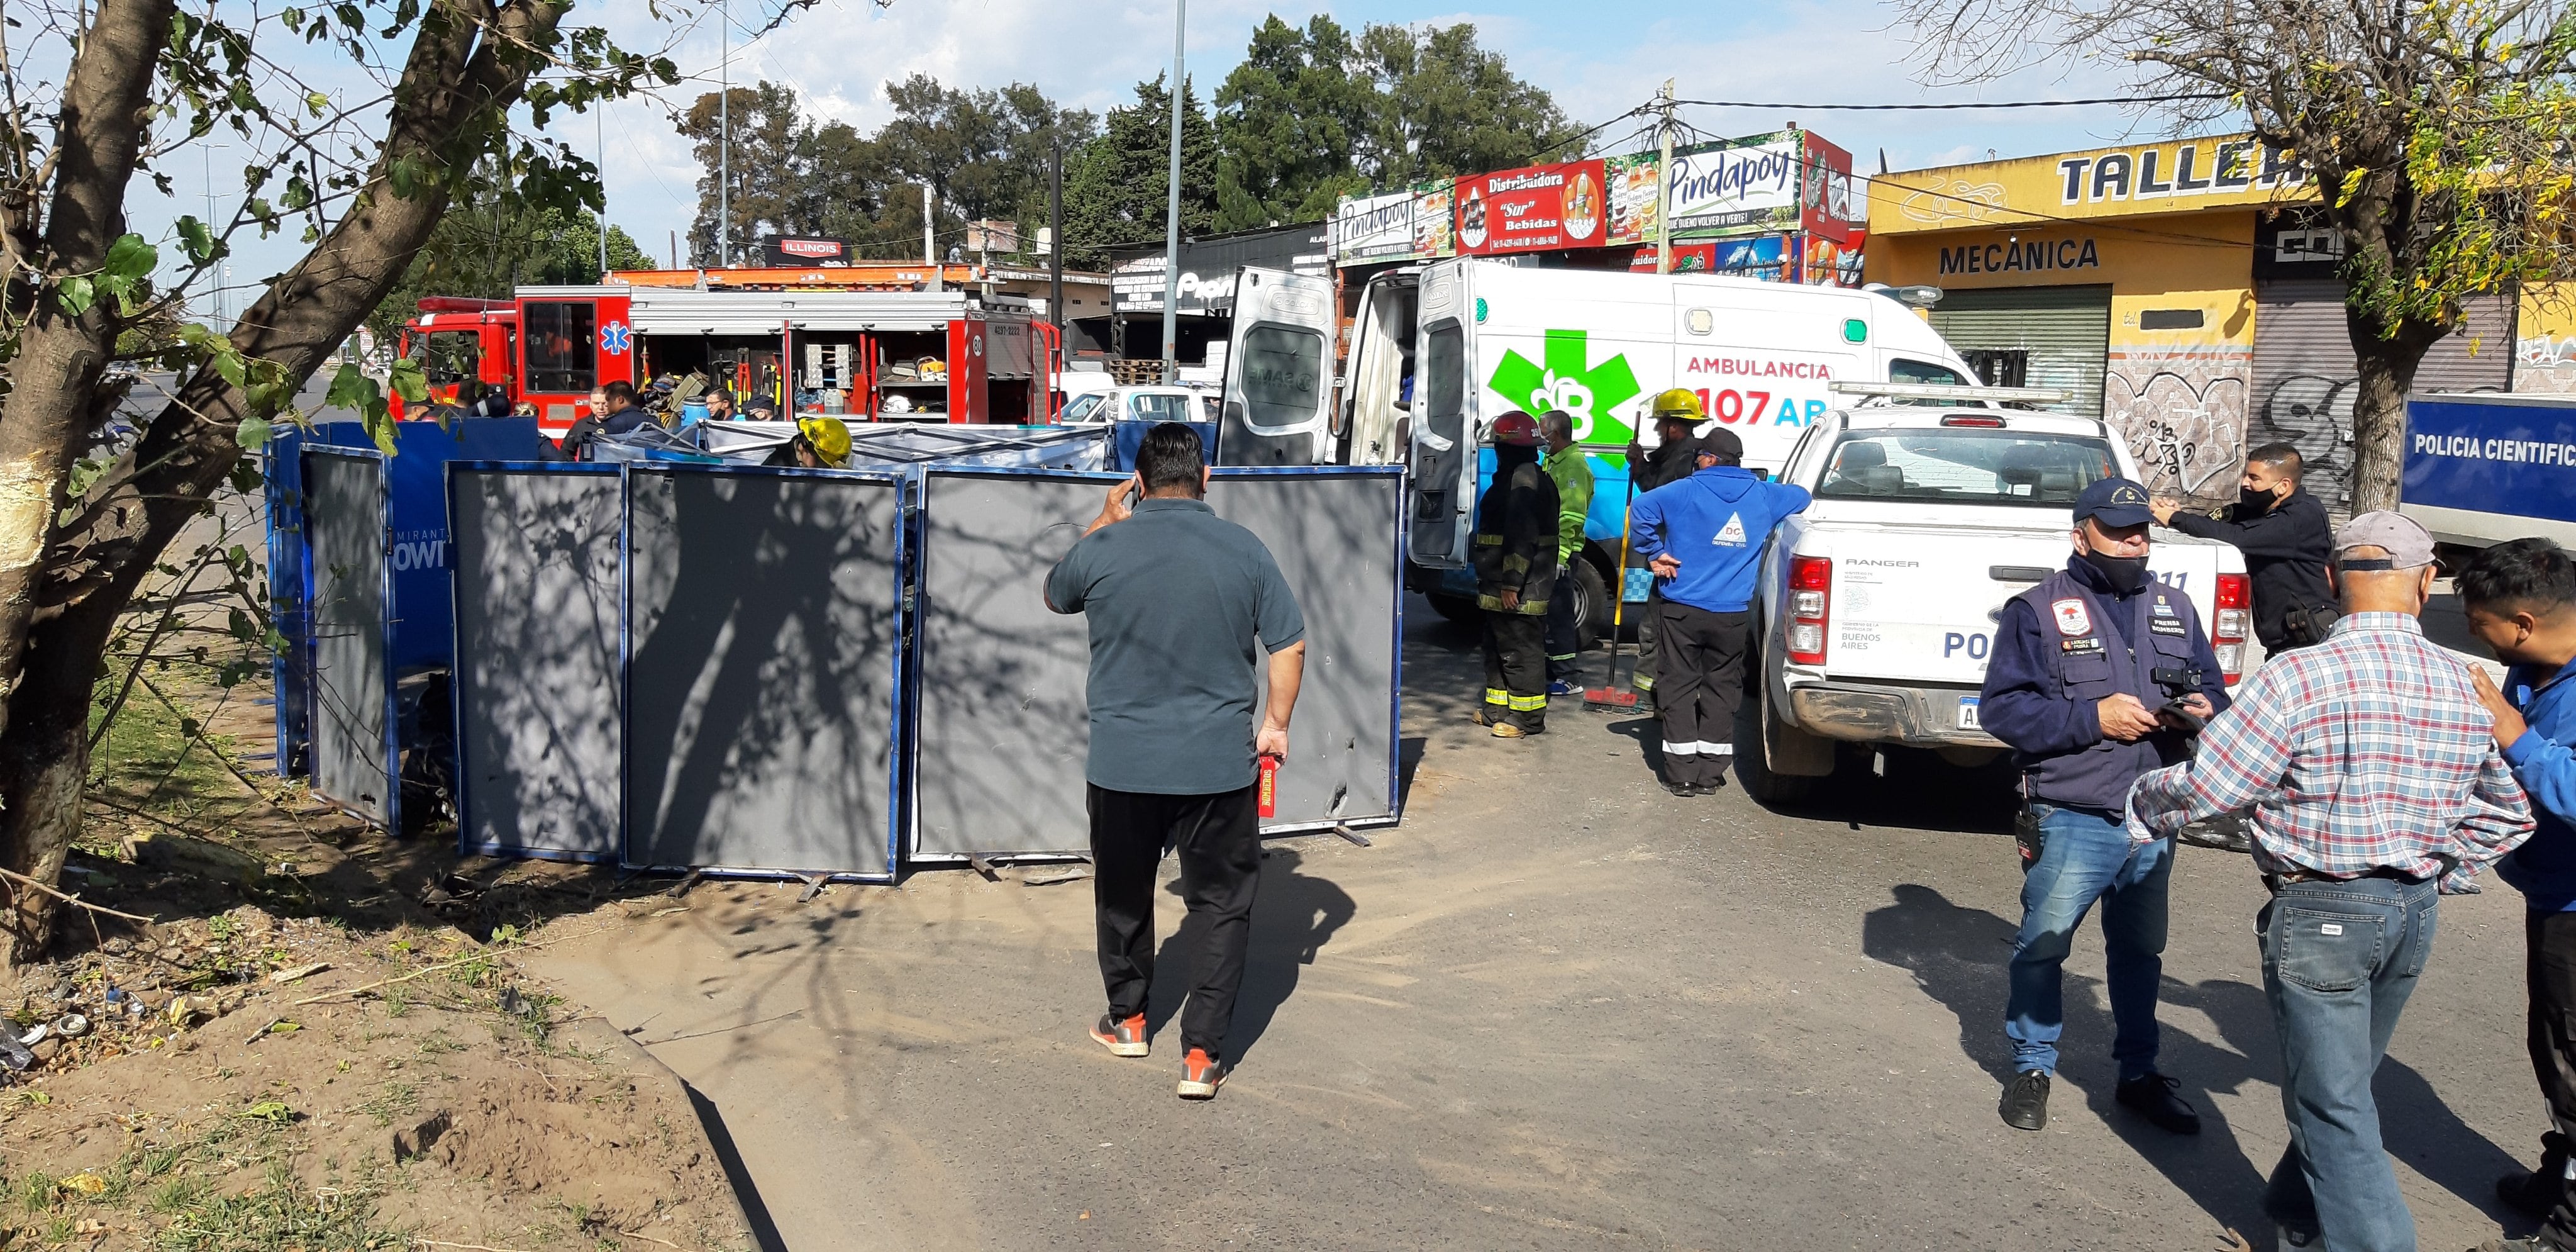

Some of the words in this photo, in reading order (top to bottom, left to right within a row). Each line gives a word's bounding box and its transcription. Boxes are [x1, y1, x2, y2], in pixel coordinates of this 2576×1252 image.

[1489, 172, 1563, 193] Distribuidora
[1668, 150, 1789, 211] Pindapoy
[1342, 199, 1409, 244] Pindapoy
[1506, 218, 1557, 231] Bebidas
[1697, 216, 1721, 226] VOLVER
[974, 338, 982, 353] 80
[1687, 357, 1831, 380] AMBULANCIA
[1694, 388, 1770, 425] 107
[1531, 428, 1540, 437] 35
[2414, 433, 2481, 459] POLICIA
[2485, 439, 2576, 467] CIENTIFIC
[1725, 527, 1741, 536] DC
[1845, 559, 1919, 567] RANGER
[1841, 632, 1880, 641] BUENOS
[2151, 625, 2185, 634] BOMBEROS
[1841, 642, 1868, 650] AIRES
[1944, 632, 1989, 660] PO
[1262, 769, 1272, 807] BOMBEROS
